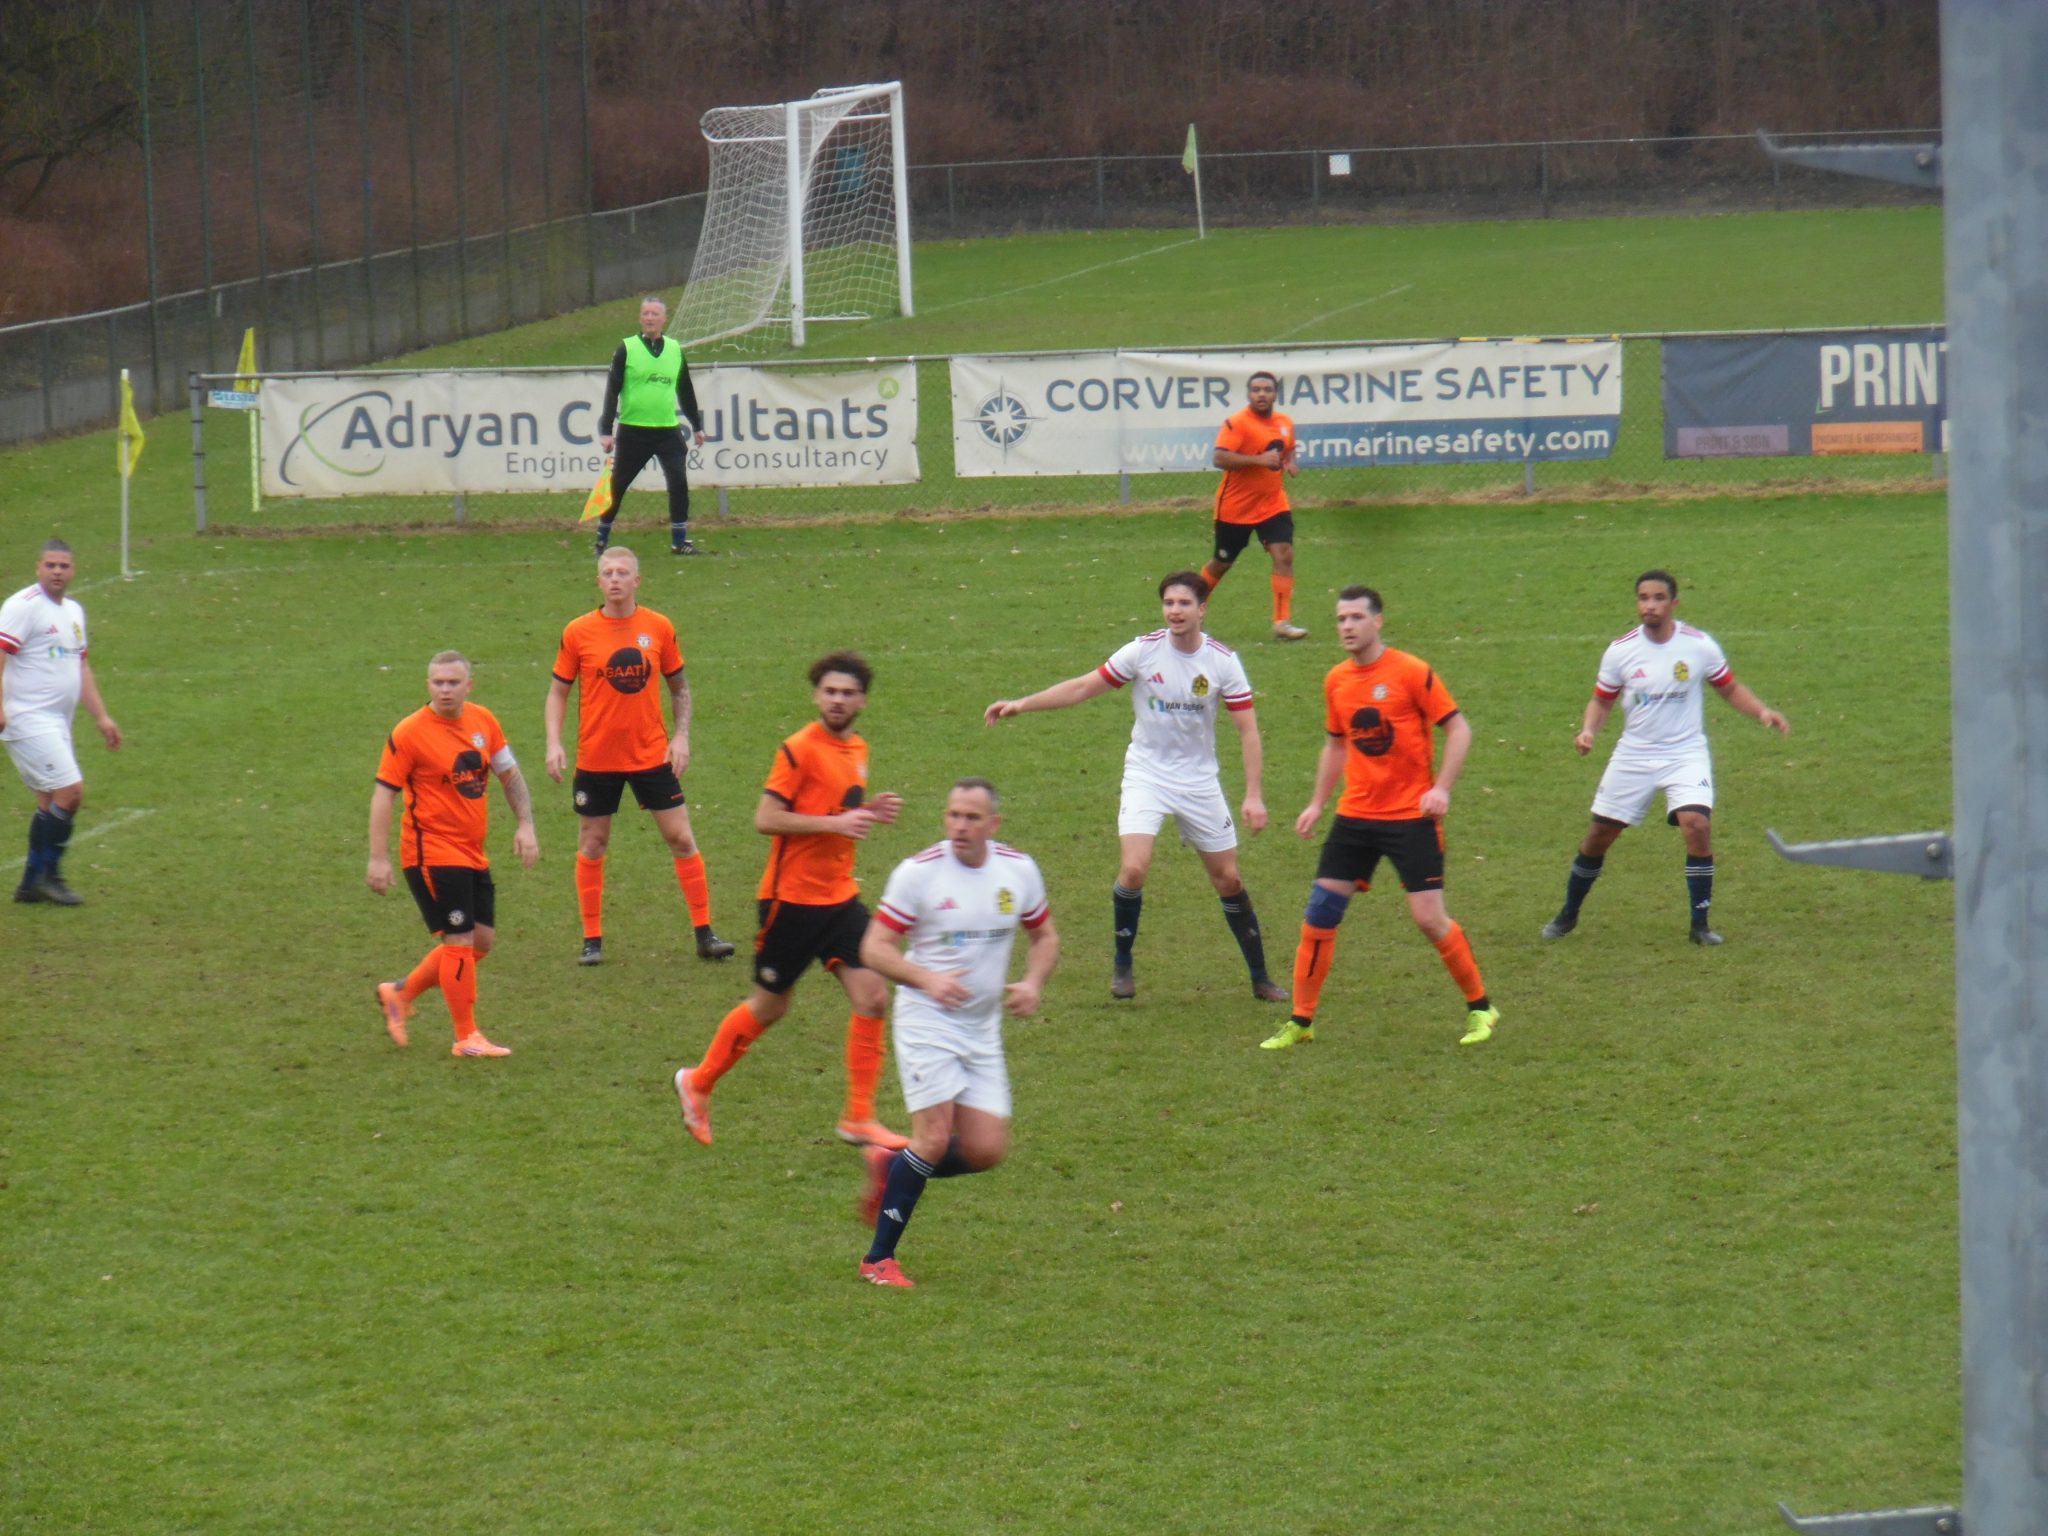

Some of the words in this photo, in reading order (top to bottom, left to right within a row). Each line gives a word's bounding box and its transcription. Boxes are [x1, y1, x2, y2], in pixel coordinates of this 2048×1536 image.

[1046, 376, 1231, 412] CORVER
[1436, 363, 1610, 400] SAFETY
[341, 400, 539, 459] Adryan
[558, 393, 889, 446] Cultants
[687, 449, 704, 470] &
[715, 445, 889, 471] Consultancy
